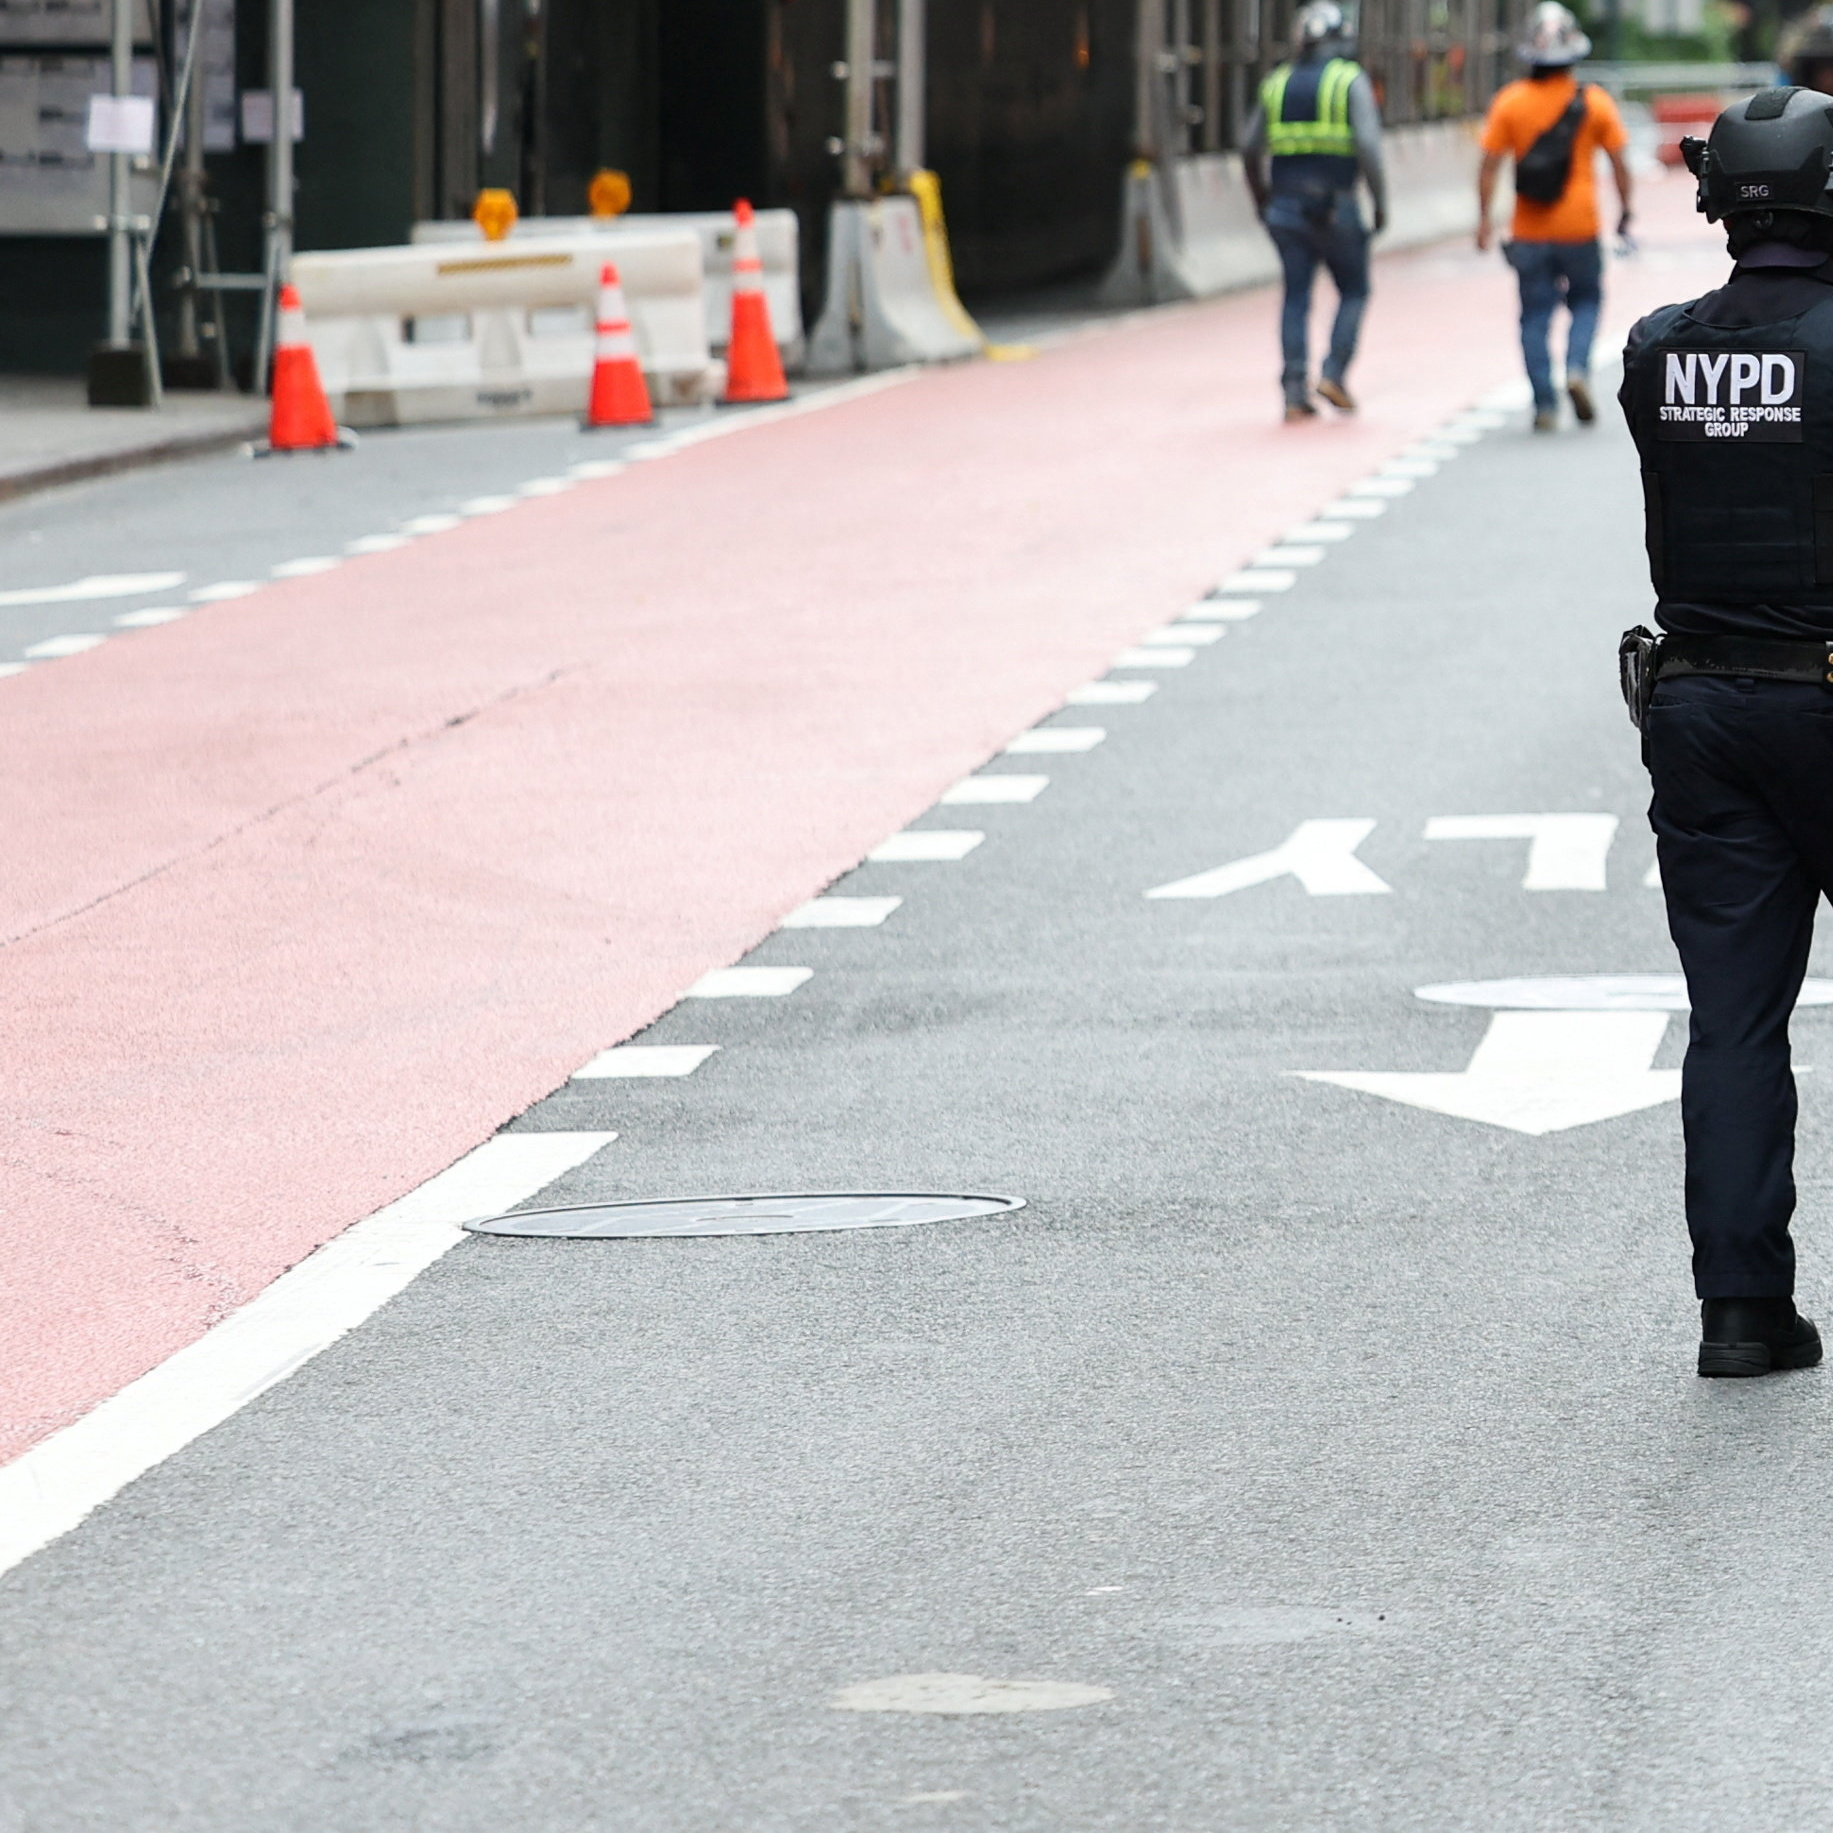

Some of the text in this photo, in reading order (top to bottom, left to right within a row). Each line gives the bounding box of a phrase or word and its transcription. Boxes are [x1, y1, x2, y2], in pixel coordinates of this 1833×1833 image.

[1740, 185, 1769, 198] SRG
[1665, 353, 1796, 405] NYPD
[1659, 406, 1801, 422] STRATEGIC RESPONSE
[1704, 421, 1749, 437] GROUP
